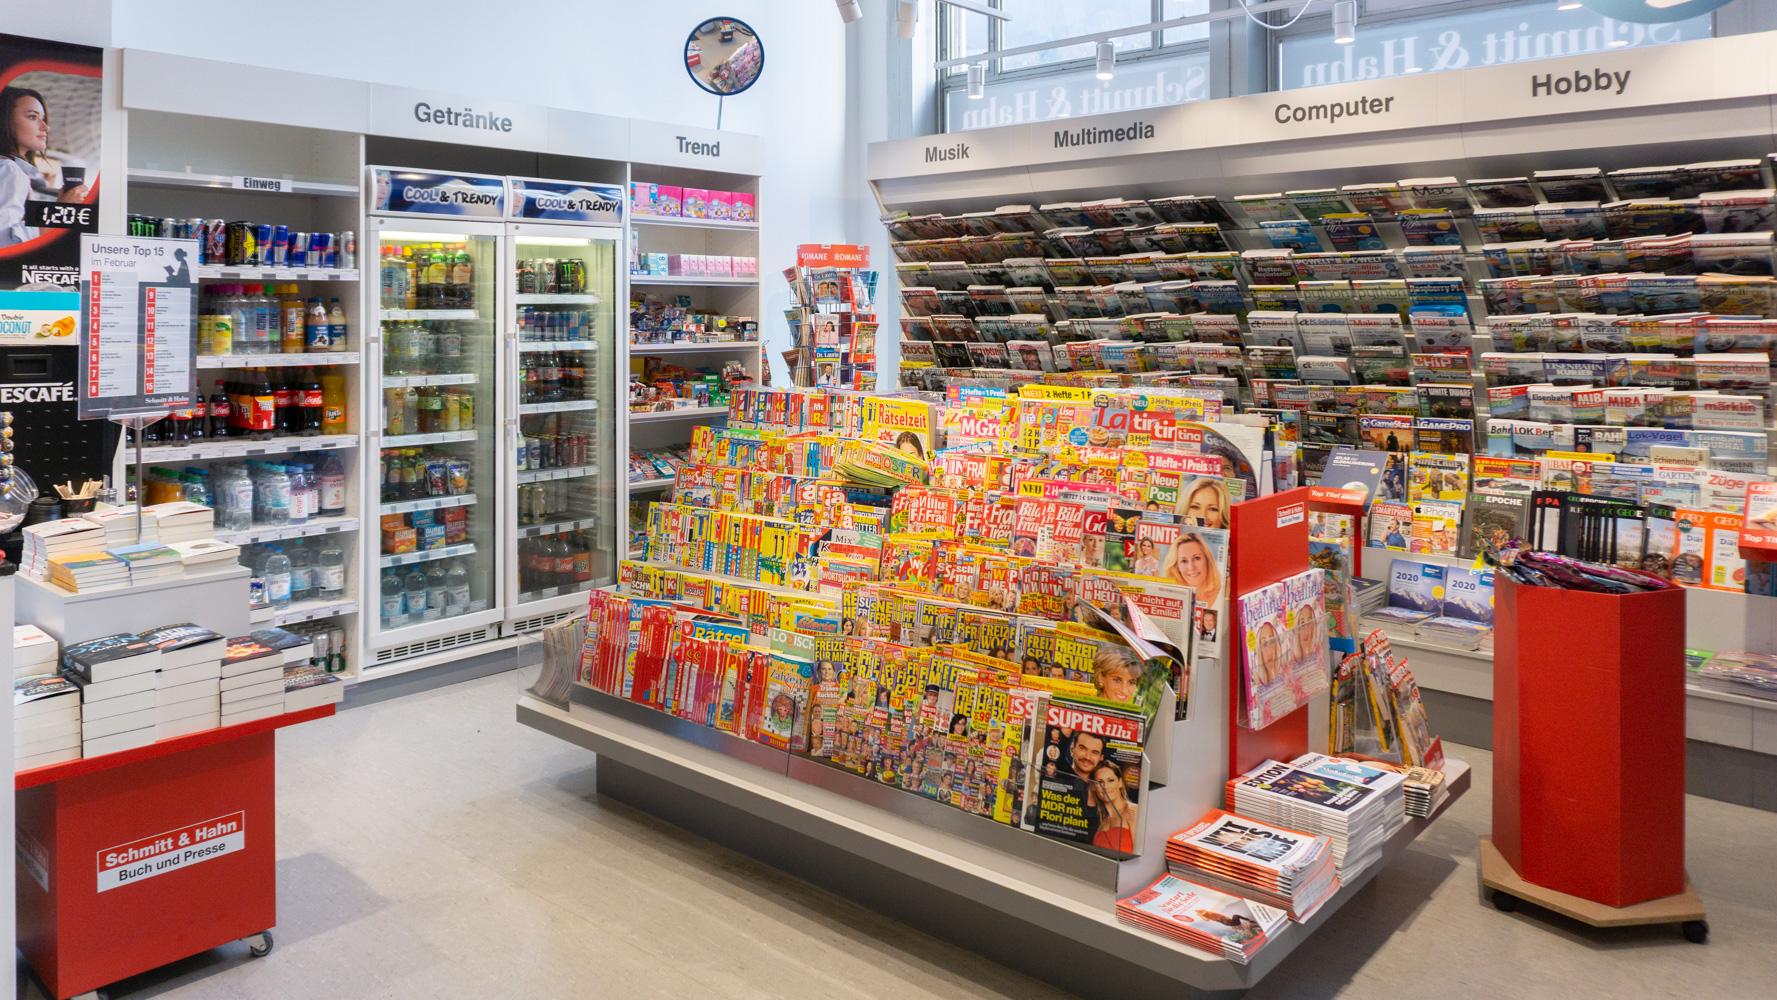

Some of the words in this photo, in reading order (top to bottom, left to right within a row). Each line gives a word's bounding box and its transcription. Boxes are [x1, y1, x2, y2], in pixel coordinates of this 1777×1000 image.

[1531, 69, 1631, 97] Hobby
[1274, 94, 1394, 125] Computer
[414, 102, 513, 132] Getränke
[1054, 121, 1155, 148] Multimedia
[676, 136, 720, 157] Trend
[924, 143, 970, 163] Musik
[243, 177, 281, 191] Einweg
[403, 186, 438, 202] COOL
[440, 190, 449, 203] &
[453, 190, 498, 206] TRENDY
[537, 197, 565, 210] COOL
[567, 198, 575, 211] &
[578, 198, 618, 214] TRENDY
[91, 243, 130, 255] Unsere
[133, 245, 150, 258] Top
[153, 247, 164, 256] 15
[835, 253, 862, 261] ROMANE
[104, 258, 137, 268] Februar
[93, 275, 98, 283] 1
[93, 291, 98, 299] 2
[92, 338, 97, 346] 5
[147, 367, 153, 375] 14
[146, 382, 153, 390] 15
[1053, 391, 1072, 399] Hefte
[1608, 396, 1641, 408] MIBA
[879, 403, 926, 428] Rätselzeit
[1177, 428, 1200, 441] tina
[1149, 455, 1154, 466] 3
[1151, 473, 1179, 487] Neue
[1709, 475, 1744, 489] Züge
[1022, 484, 1042, 494] NEU
[1149, 487, 1177, 503] Post
[1486, 496, 1523, 506] EPOCHE
[1424, 506, 1455, 517] iPhone
[1396, 571, 1419, 582] 2020
[1452, 580, 1476, 591] 2020
[1143, 597, 1165, 606] nicht
[1151, 608, 1180, 618] Emilia!
[695, 628, 747, 645] Rätsel
[1048, 707, 1105, 735] SUPER
[1105, 724, 1132, 740] illu
[1243, 764, 1291, 788] EDITION
[1042, 789, 1061, 803] Was
[1063, 793, 1081, 805] der
[1041, 800, 1065, 813] MDR
[1066, 804, 1083, 817] mit
[1040, 810, 1062, 823] Flori
[1063, 814, 1088, 828] plant
[105, 836, 174, 867] Schmitt
[178, 832, 190, 846] &
[195, 821, 237, 842] Hahn
[119, 863, 153, 882] Buch
[156, 854, 180, 870] und
[184, 841, 226, 862] Presse
